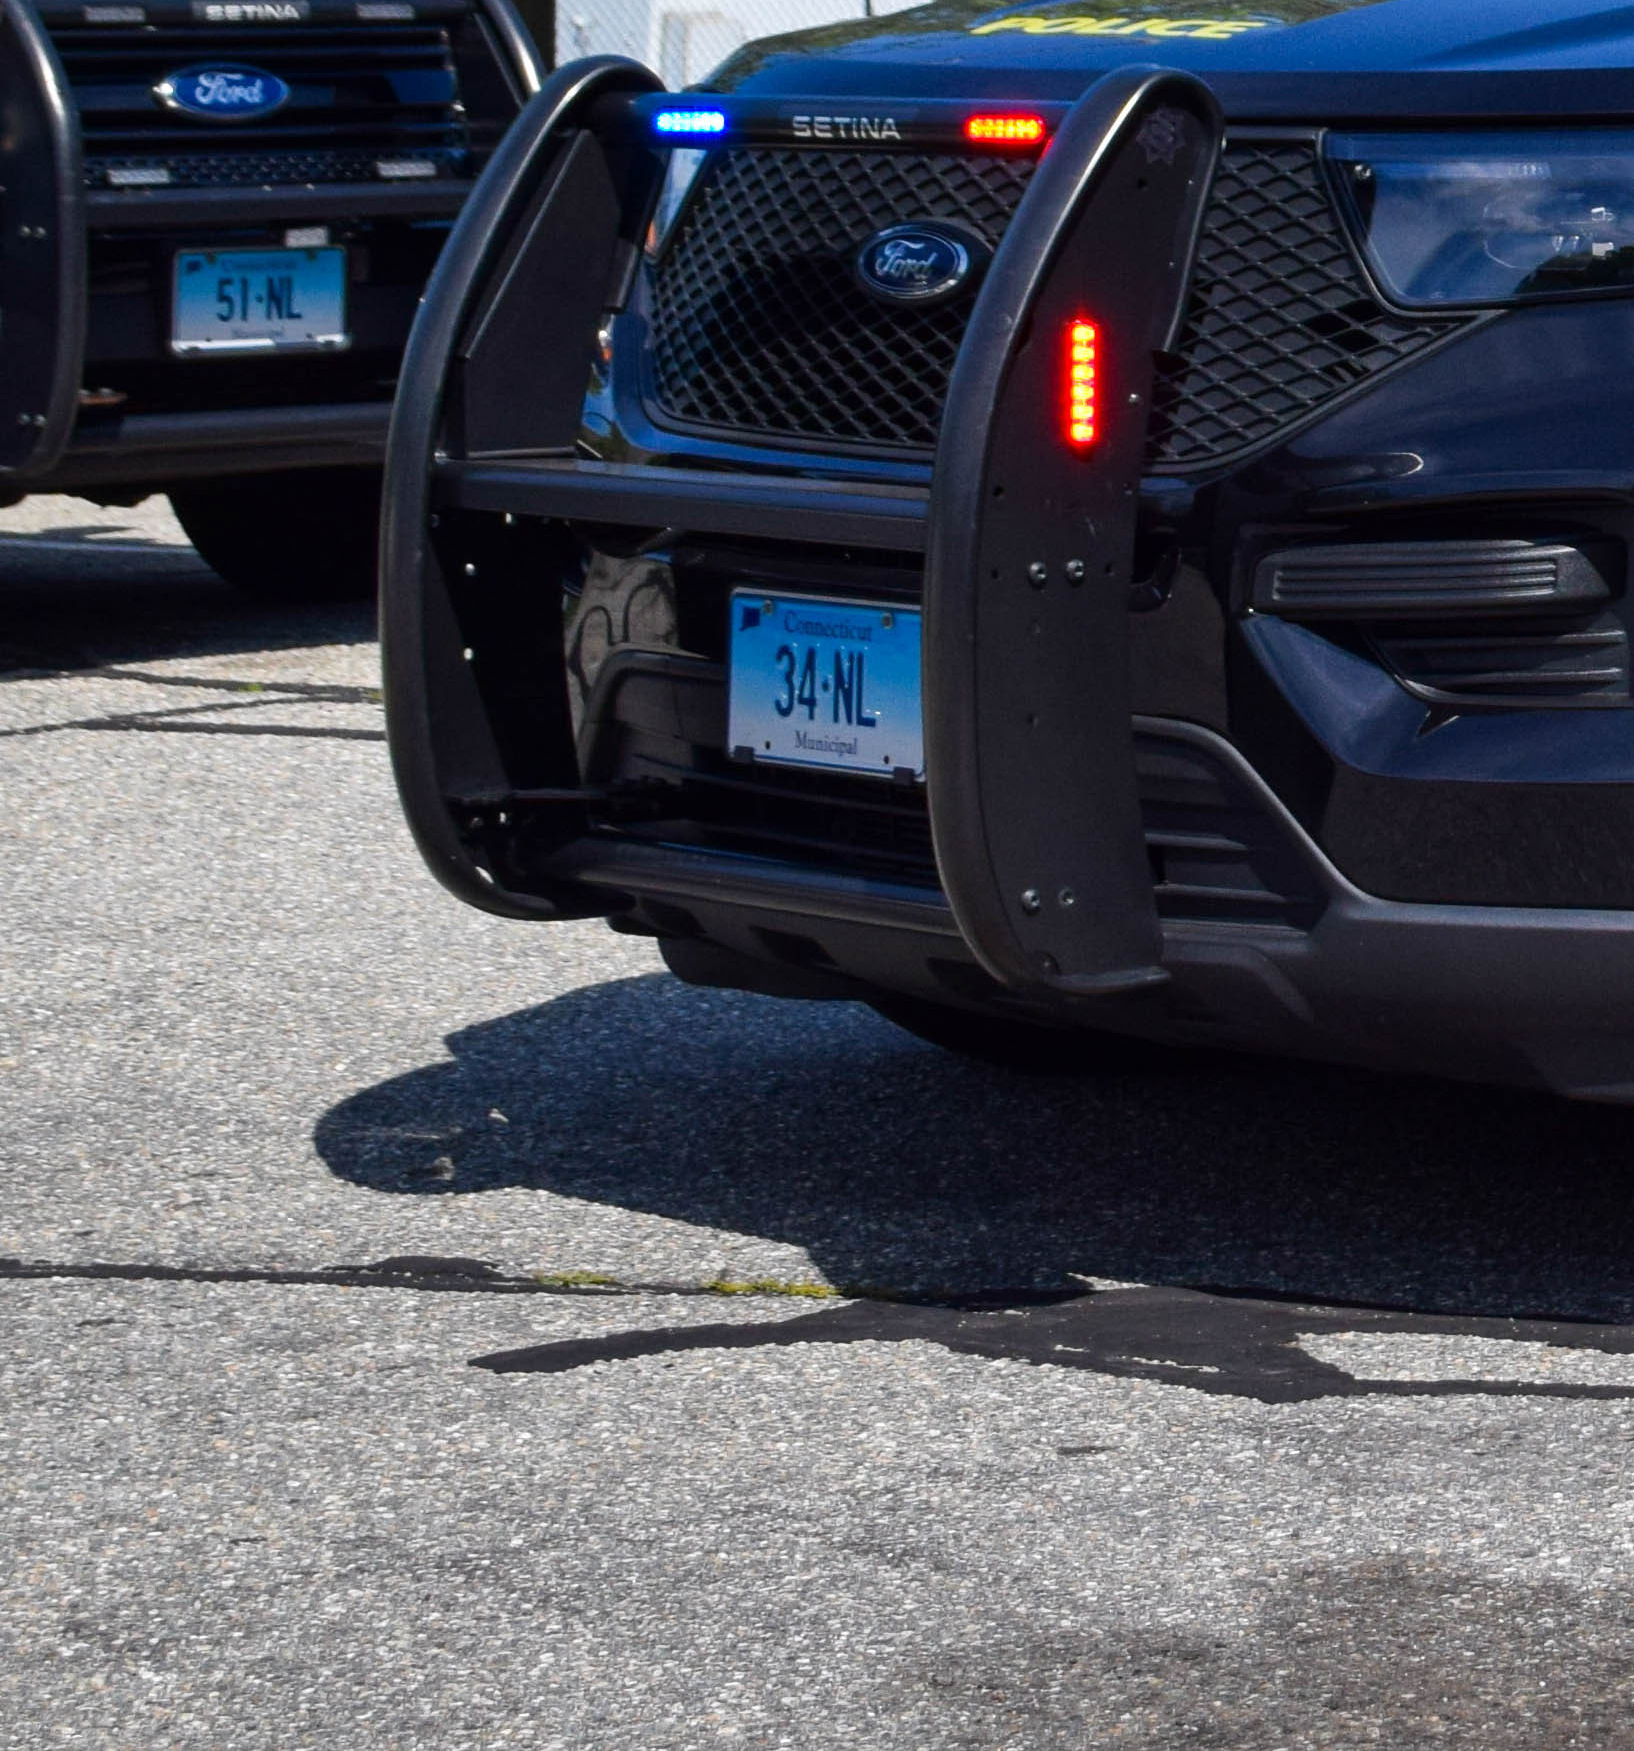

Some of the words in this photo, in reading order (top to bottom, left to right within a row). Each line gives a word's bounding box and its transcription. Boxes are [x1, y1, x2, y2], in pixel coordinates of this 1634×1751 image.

[970, 16, 1268, 39] POLICE
[194, 71, 264, 105] Ford
[792, 115, 901, 140] SETINA
[874, 239, 936, 281] Ford
[784, 610, 873, 642] Connecticut
[795, 730, 858, 757] Municipal
